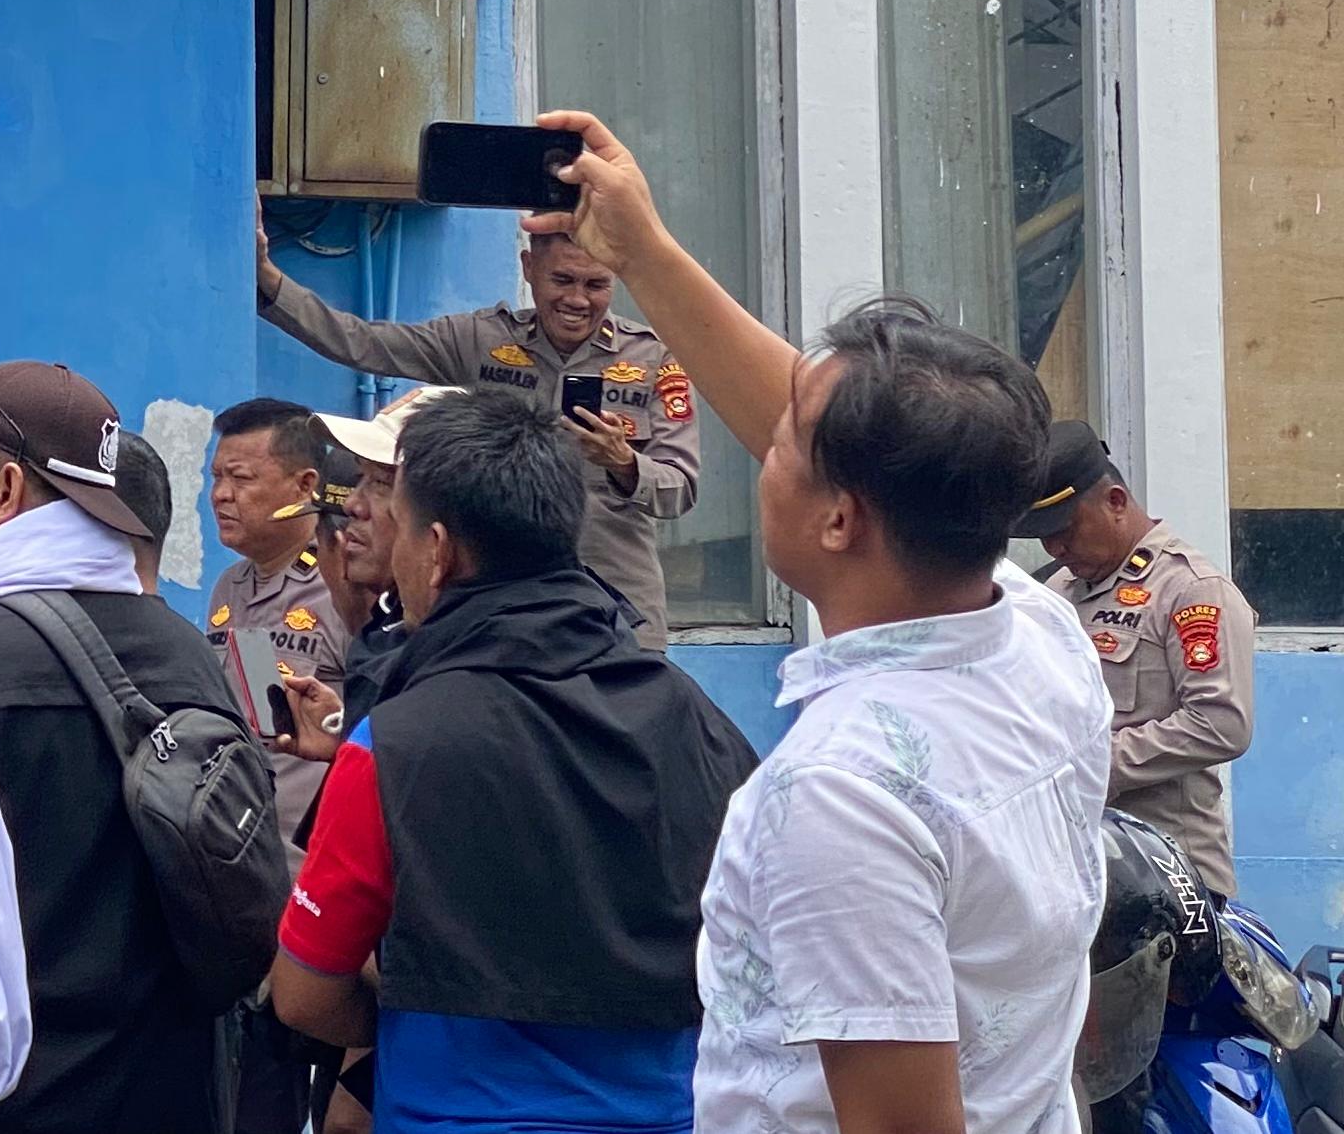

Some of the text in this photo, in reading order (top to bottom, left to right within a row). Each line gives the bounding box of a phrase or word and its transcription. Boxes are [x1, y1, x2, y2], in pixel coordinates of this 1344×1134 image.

[1091, 610, 1142, 629] POLRI
[1174, 605, 1217, 623] POLRES
[1151, 852, 1209, 935] NHK
